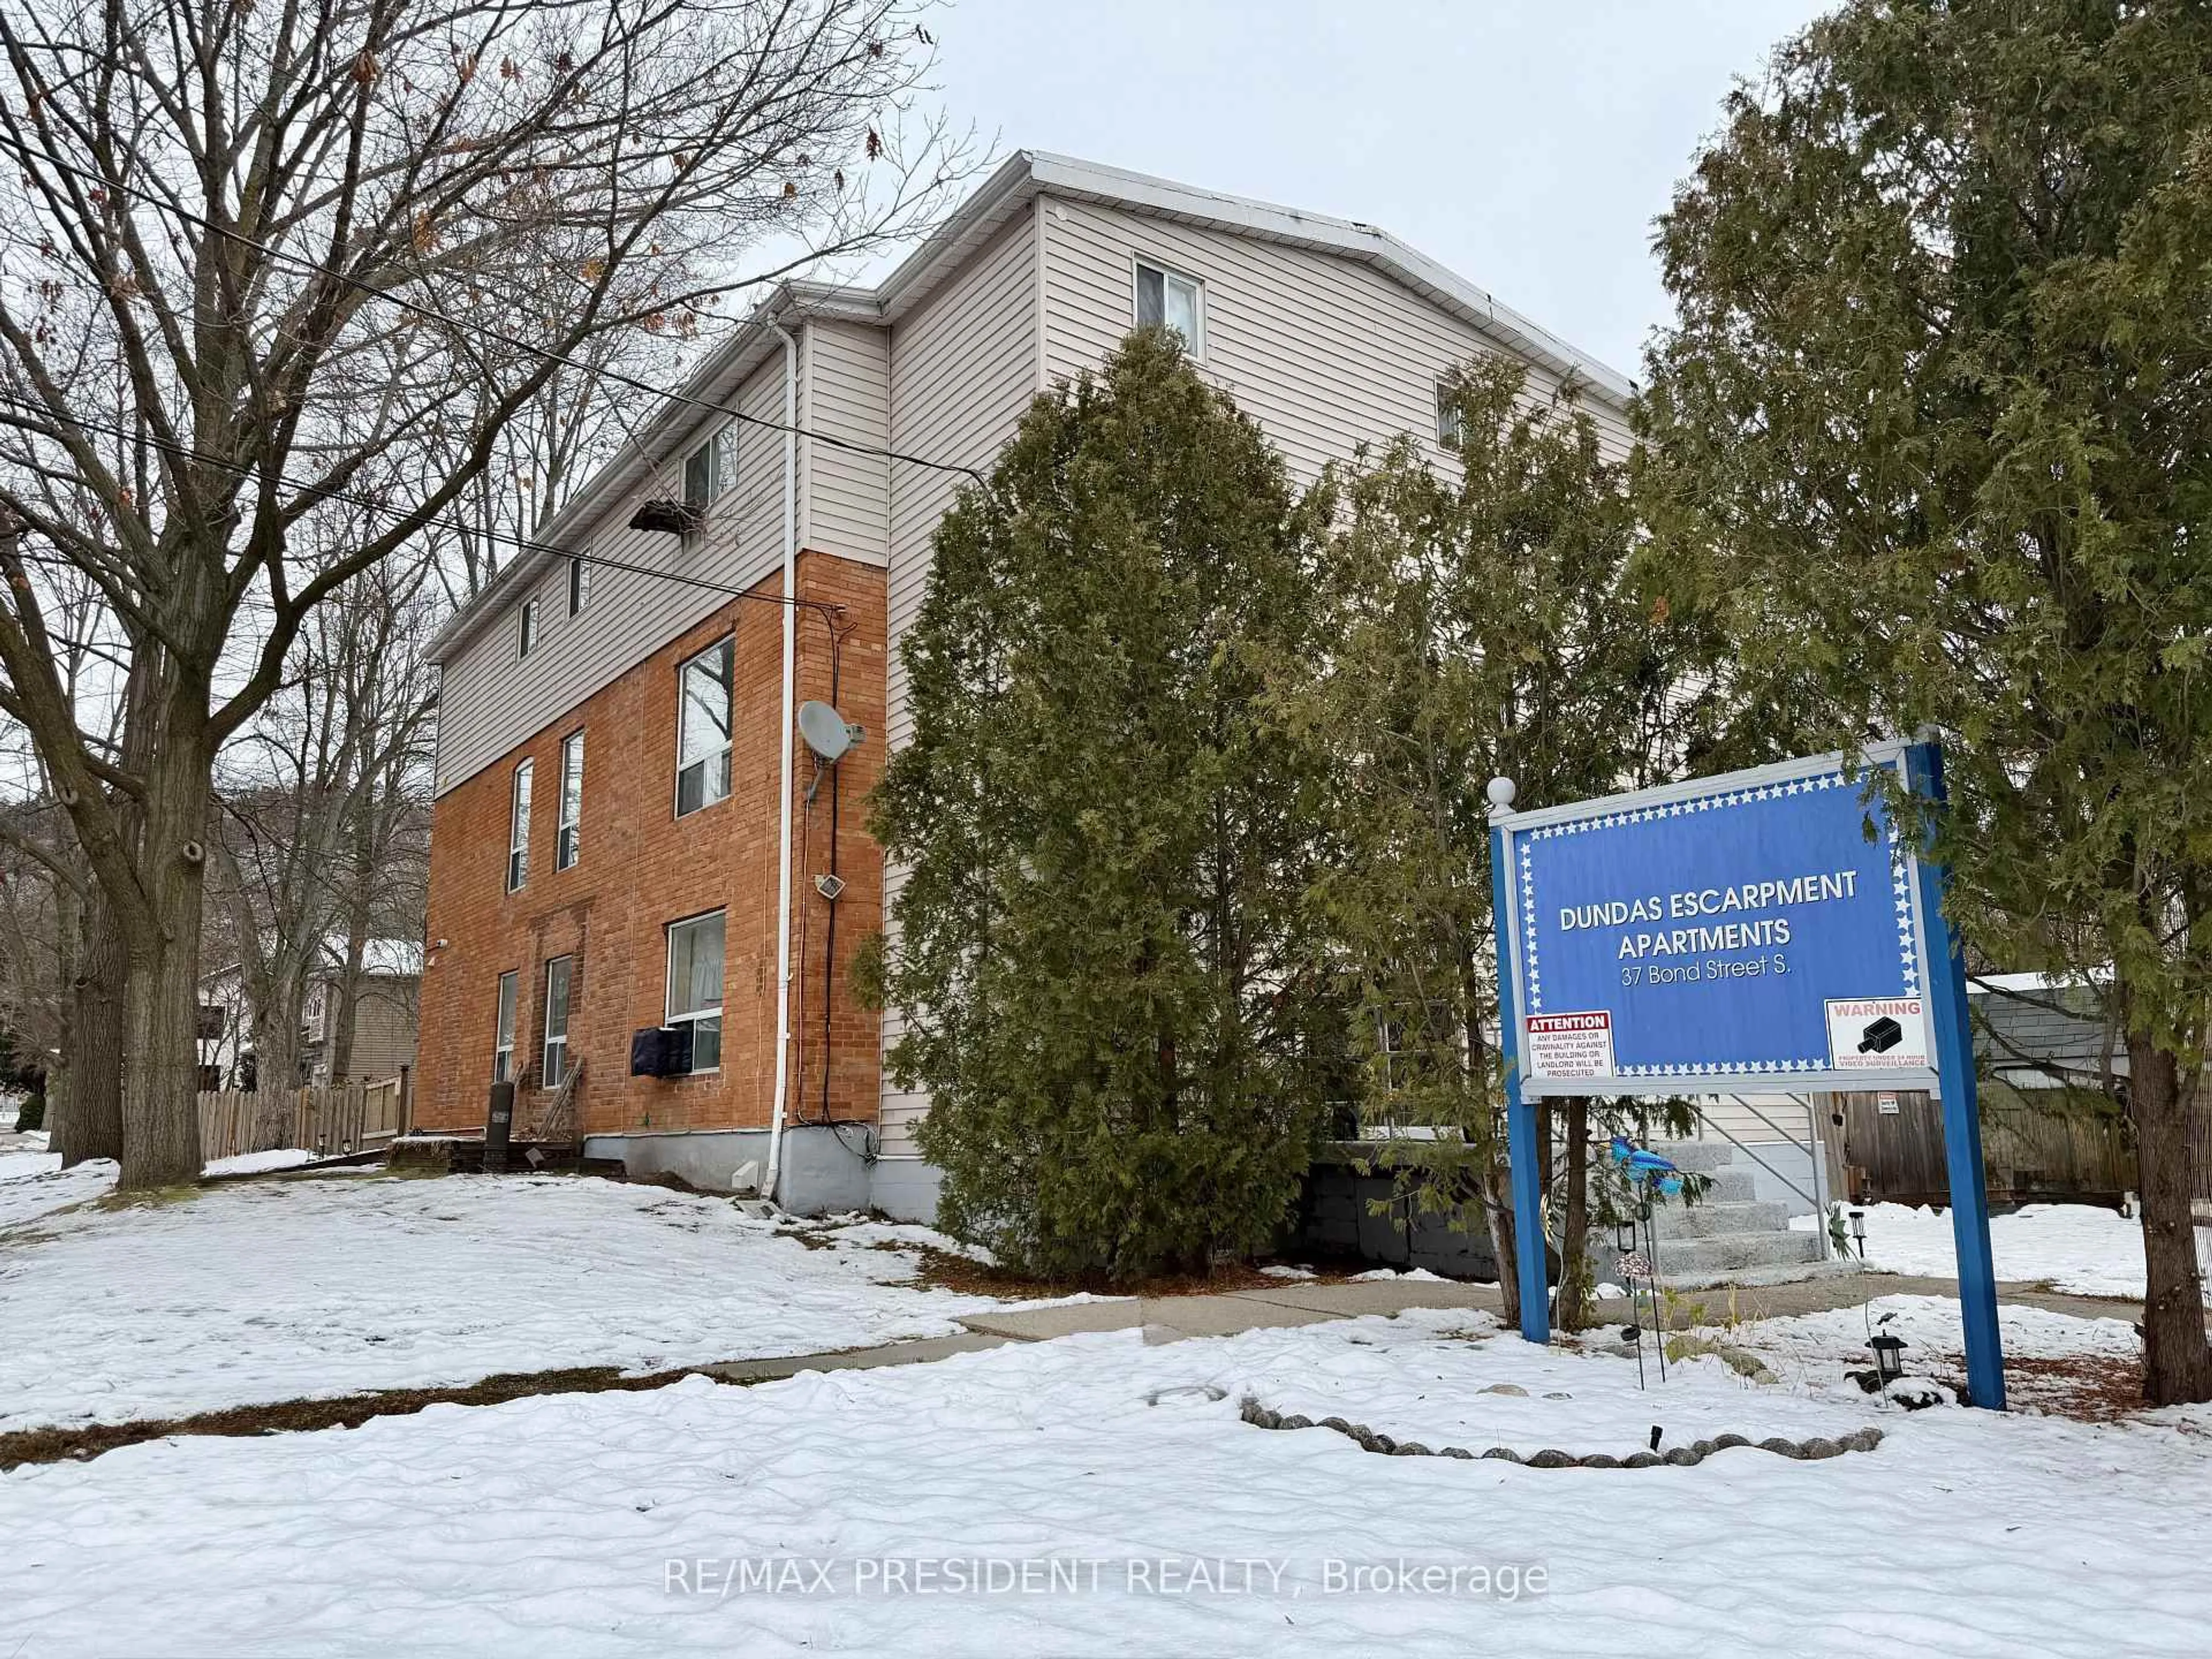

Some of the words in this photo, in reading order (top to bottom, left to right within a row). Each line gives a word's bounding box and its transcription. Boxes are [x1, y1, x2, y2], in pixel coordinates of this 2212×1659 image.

[1560, 897, 1662, 931] DUNDAS
[1671, 870, 1857, 918] ESCARPMENT
[1618, 919, 1791, 960] APARTMENTS
[1622, 968, 1642, 986] 37
[1649, 962, 1700, 984] Bond
[1707, 956, 1768, 980] Street
[1774, 954, 1792, 974] S.
[1834, 1002, 1921, 1016] WARNING
[1530, 1016, 1605, 1031] ATTENTION
[1553, 1033, 1586, 1041] DAMAGES
[1532, 1043, 1574, 1051] CRIMINALITY
[1547, 1069, 1594, 1077] PROSECUTED
